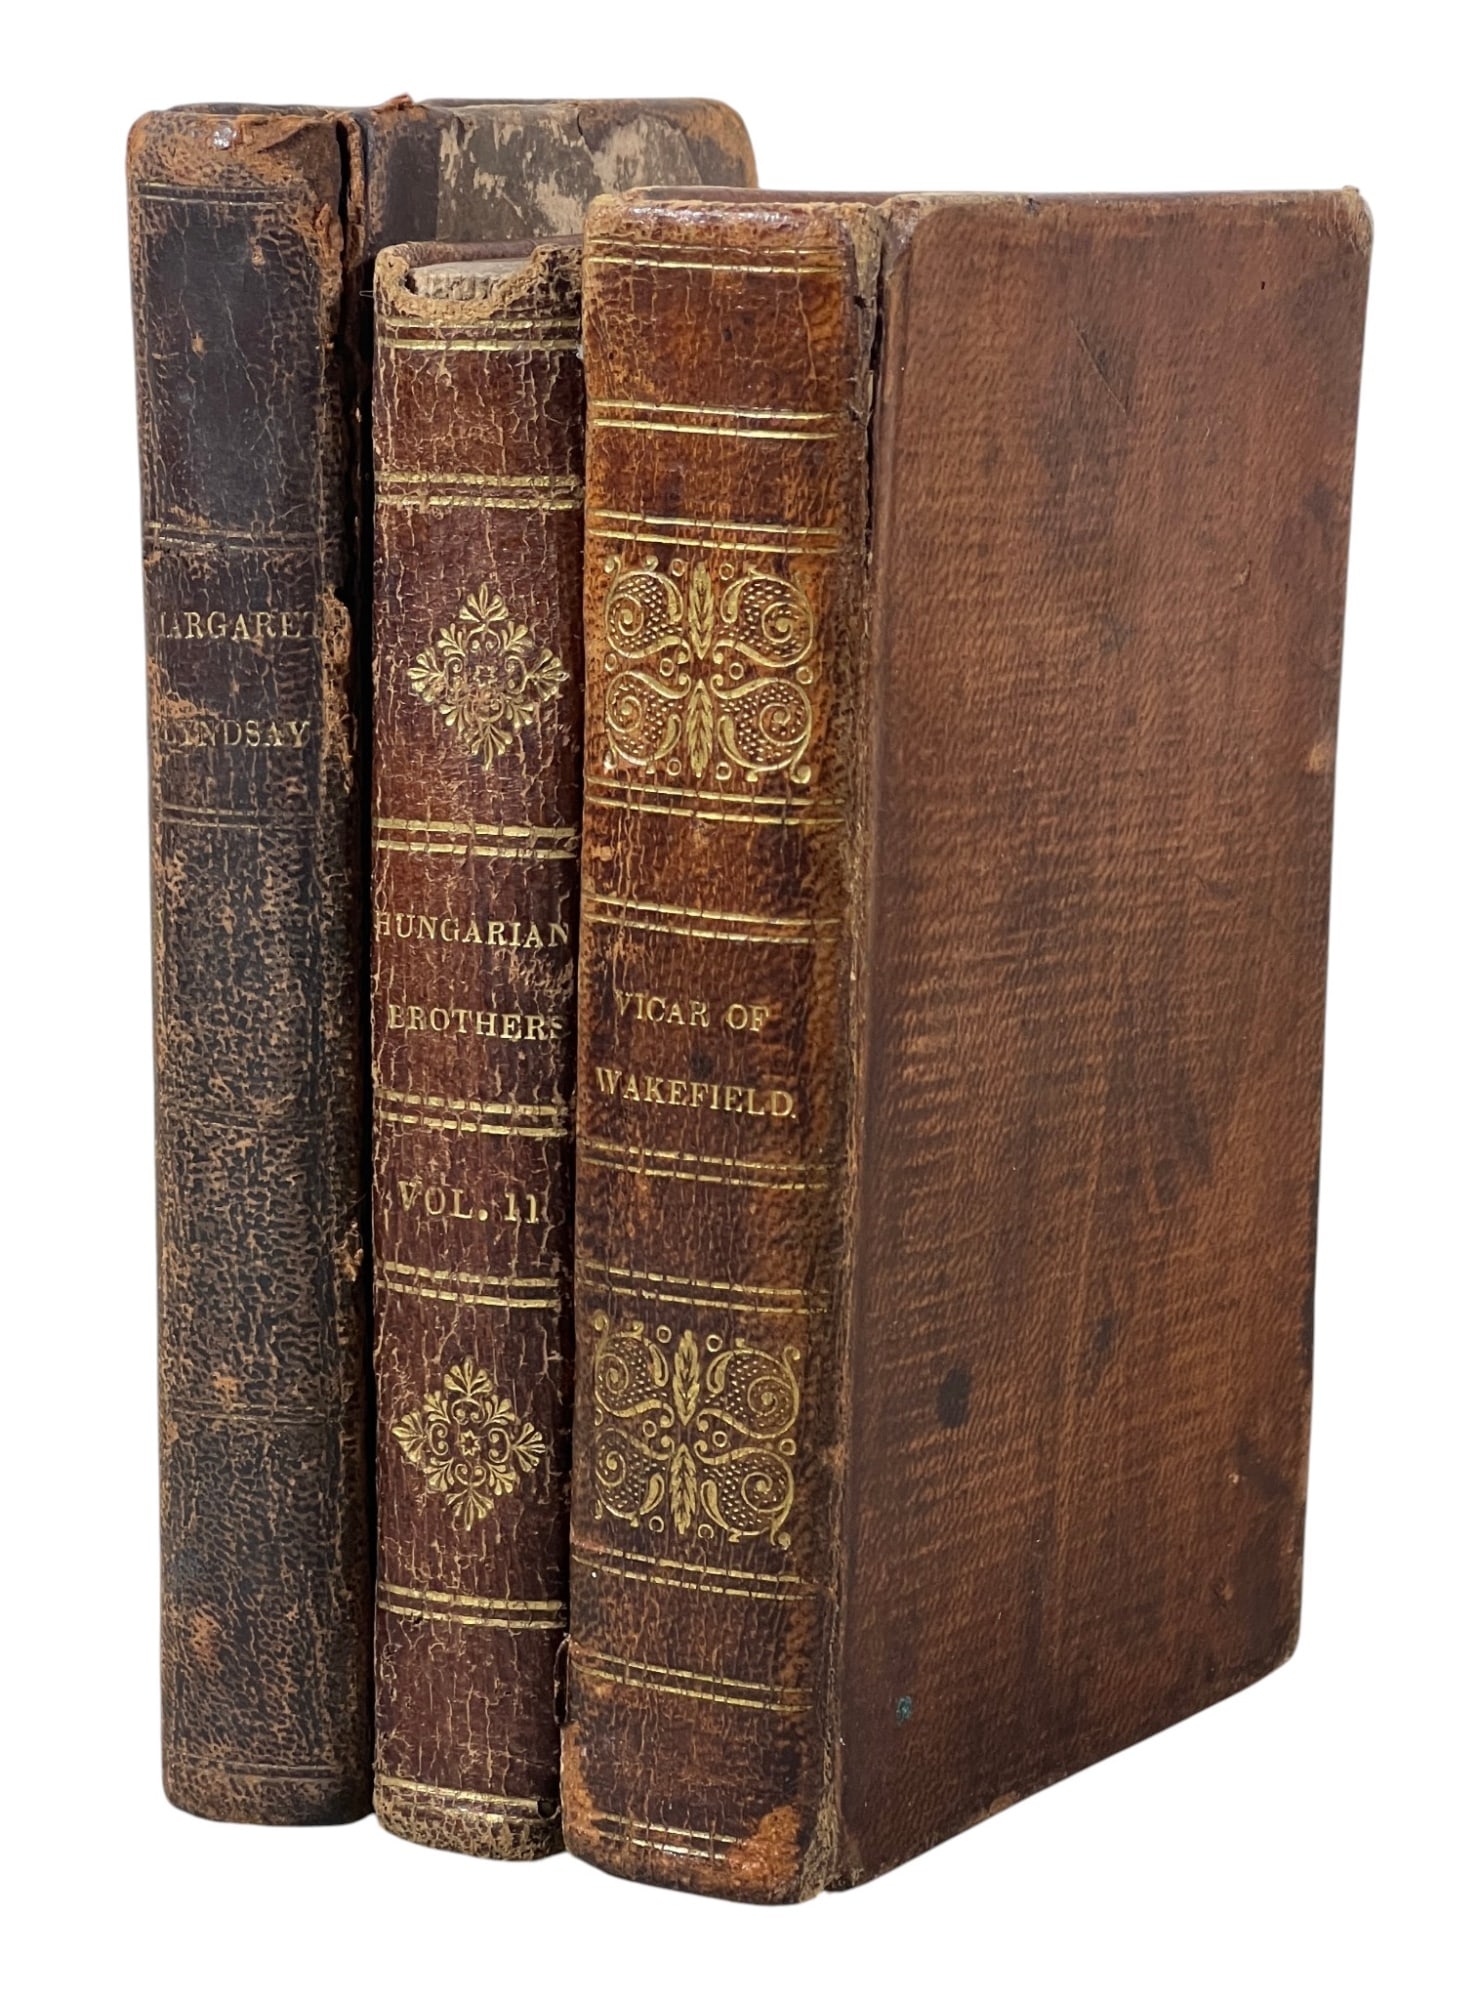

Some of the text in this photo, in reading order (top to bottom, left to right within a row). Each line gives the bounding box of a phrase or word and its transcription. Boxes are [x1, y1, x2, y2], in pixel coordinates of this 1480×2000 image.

[375, 911, 569, 948] HUNGARIAN
[388, 1004, 568, 1041] BROTHERS
[615, 988, 770, 1032] VICAR OF
[595, 1066, 798, 1119] WAKEFIELD.
[398, 1180, 489, 1222] VOL.
